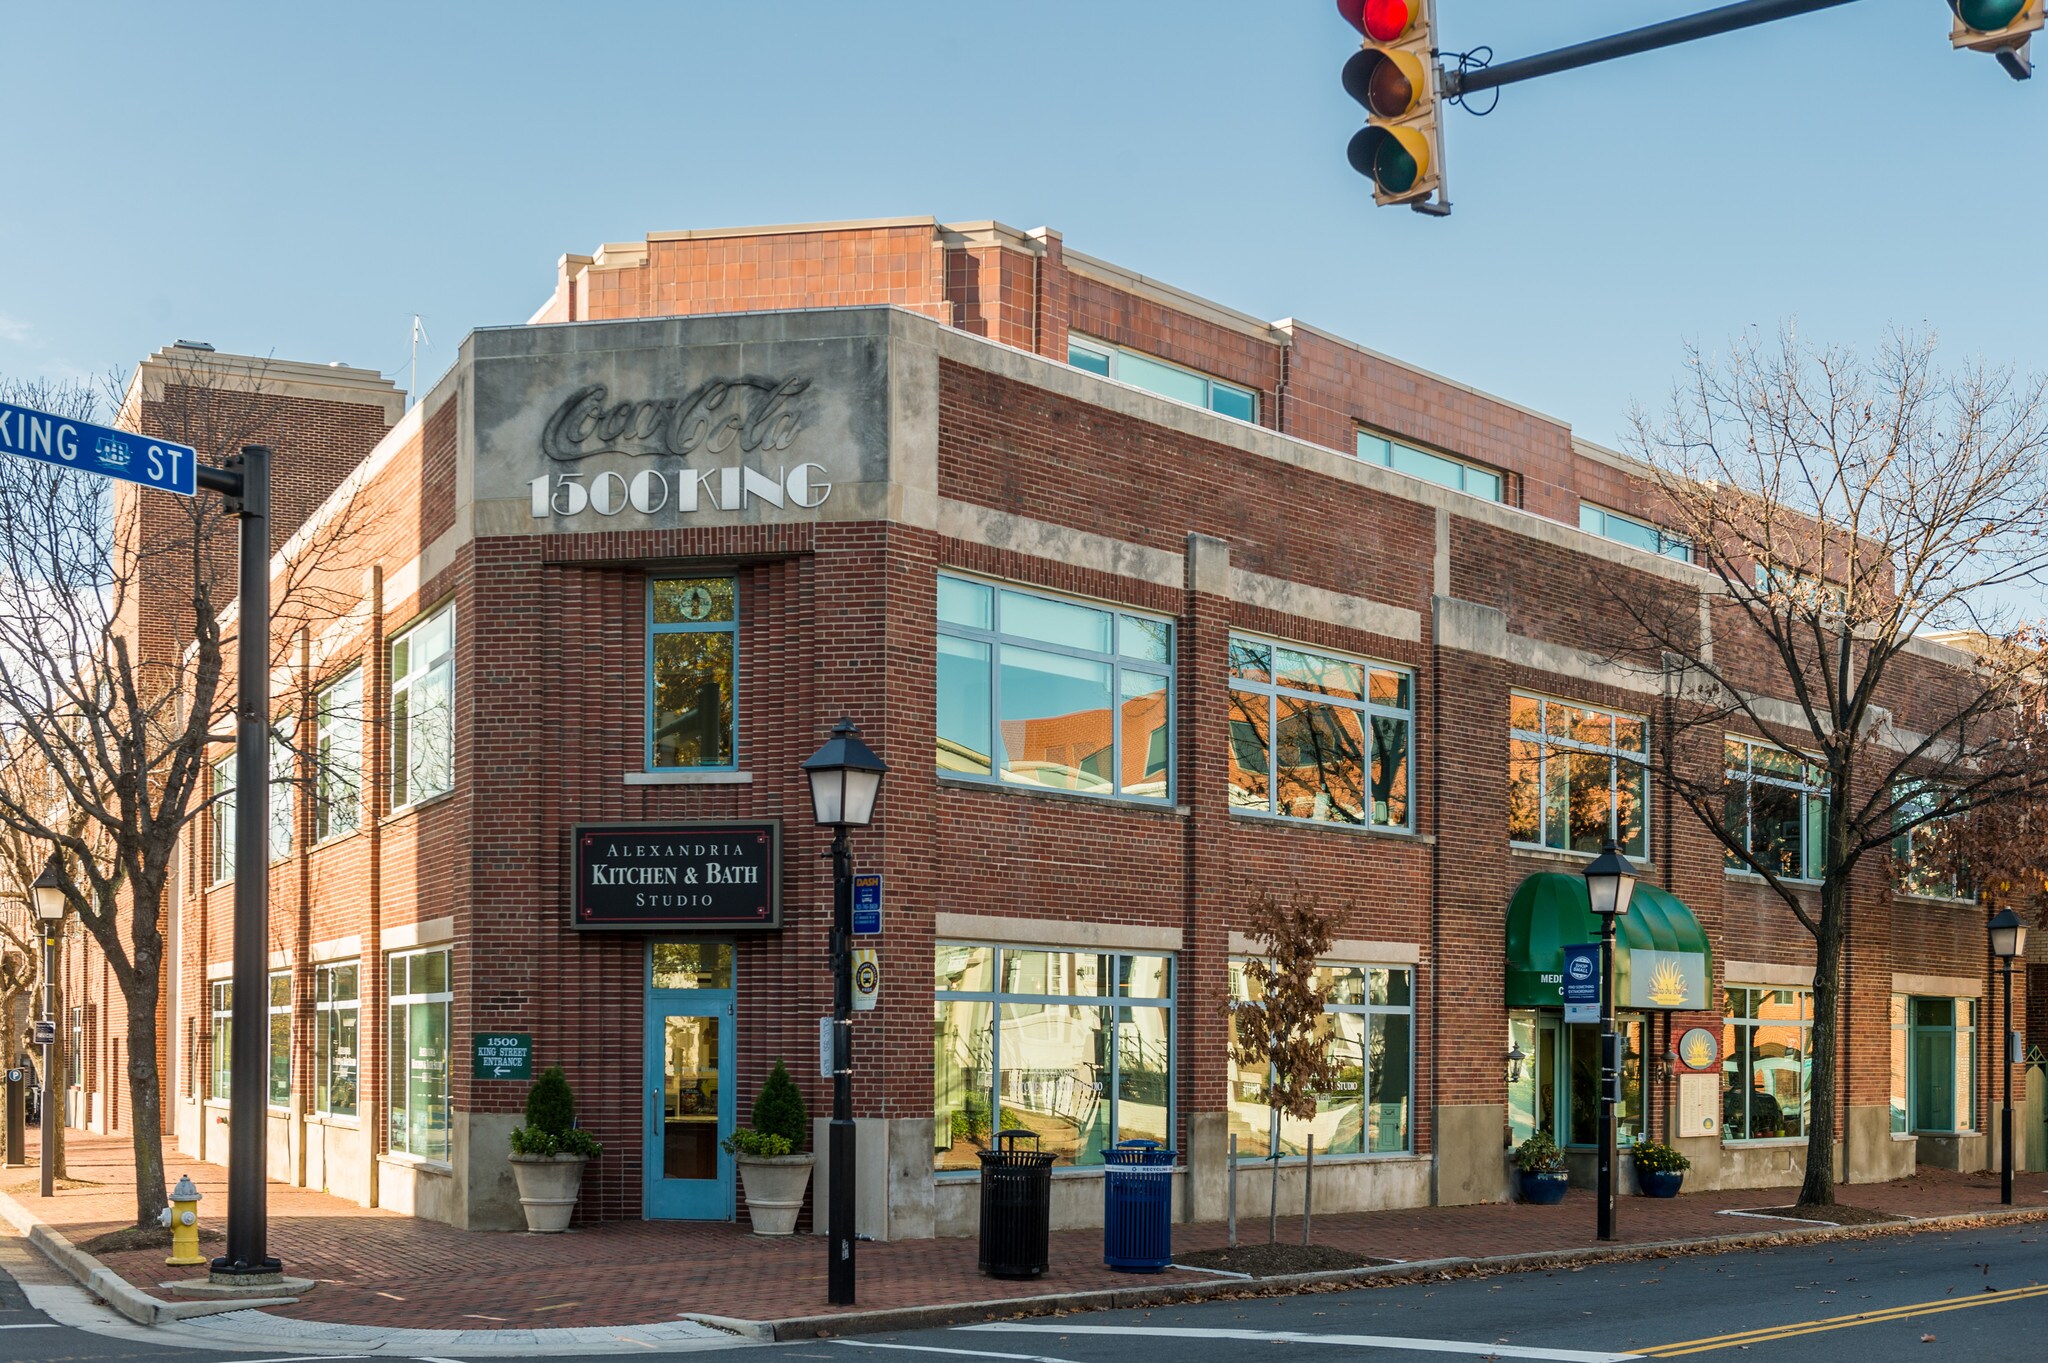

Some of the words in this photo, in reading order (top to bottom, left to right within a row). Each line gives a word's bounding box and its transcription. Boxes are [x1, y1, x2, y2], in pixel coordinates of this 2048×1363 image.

[147, 445, 183, 485] ST
[526, 469, 668, 518] 1500
[679, 462, 832, 512] KING
[606, 844, 744, 857] ALEXANDRIA
[591, 863, 677, 885] KITCHEN
[684, 867, 699, 884] &
[705, 862, 758, 884] BATH
[856, 877, 879, 887] DASH
[636, 893, 713, 906] STUDIO
[487, 1037, 518, 1047] 1500
[477, 1047, 497, 1057] KING
[499, 1047, 527, 1057] STREET
[482, 1057, 523, 1067] ENTRANCE
[1336, 1080, 1358, 1091] STUDIO
